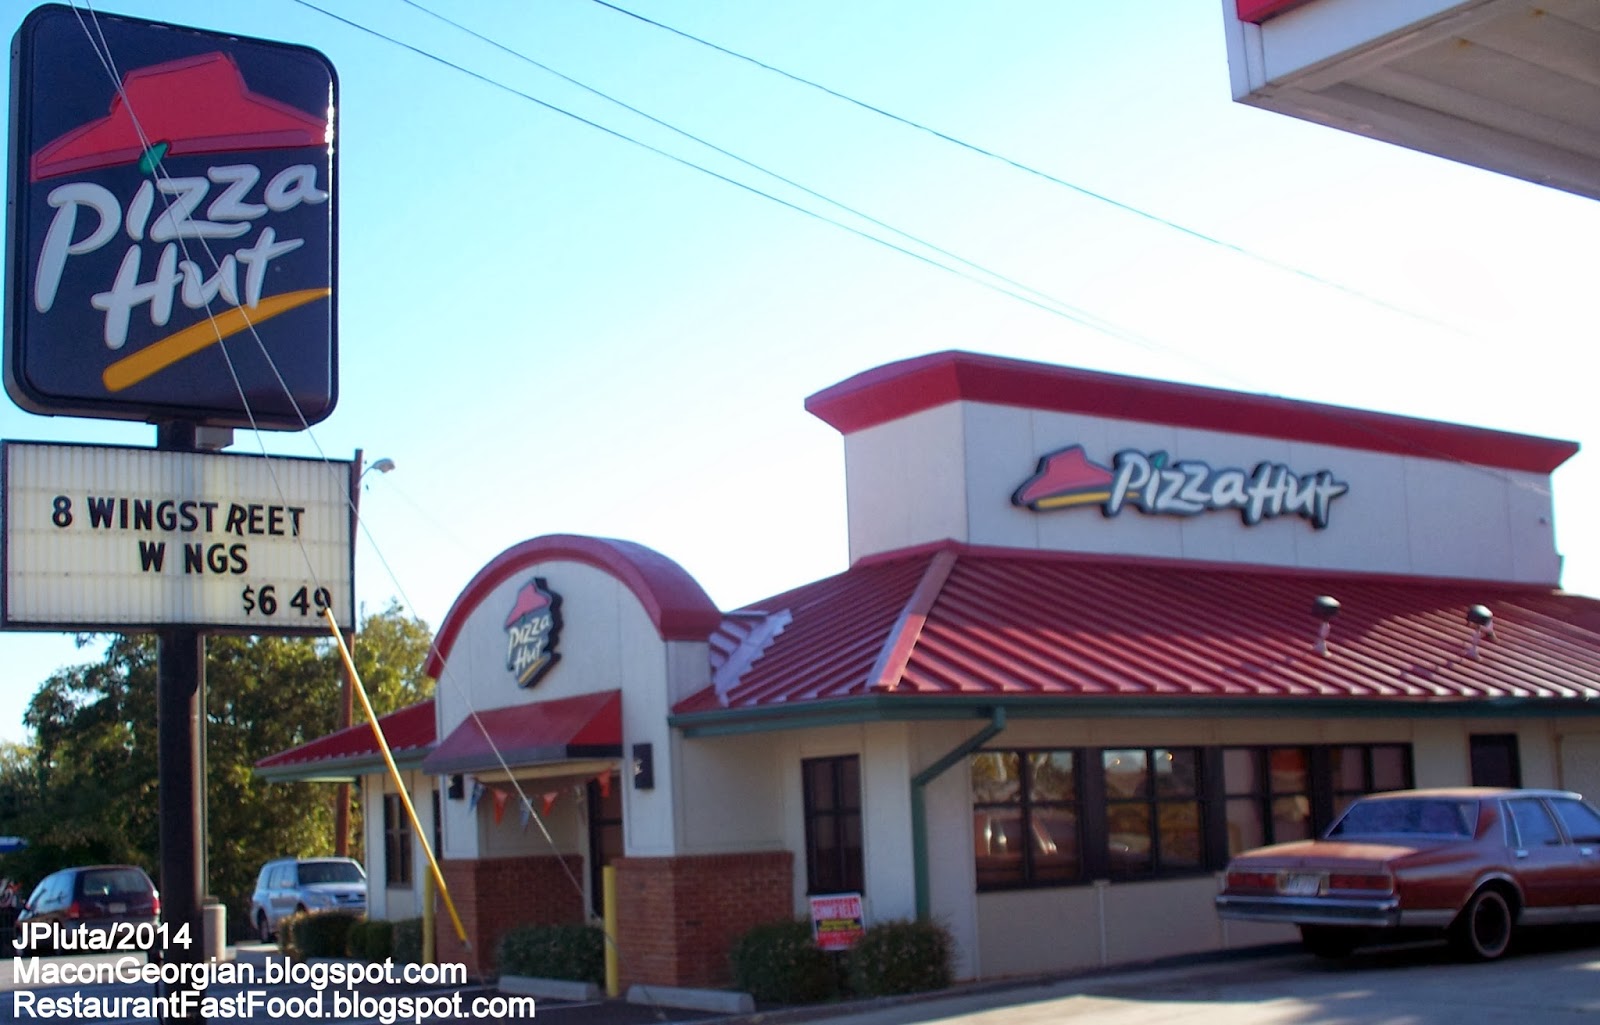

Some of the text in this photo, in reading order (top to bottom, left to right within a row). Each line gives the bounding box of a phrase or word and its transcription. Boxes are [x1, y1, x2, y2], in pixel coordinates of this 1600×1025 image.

[35, 141, 329, 314] Pizza
[90, 225, 305, 350] Hut
[51, 495, 73, 528] 8
[1109, 451, 1348, 528] Pizza Hut
[508, 615, 550, 666] Pizza
[513, 638, 544, 677] Hut
